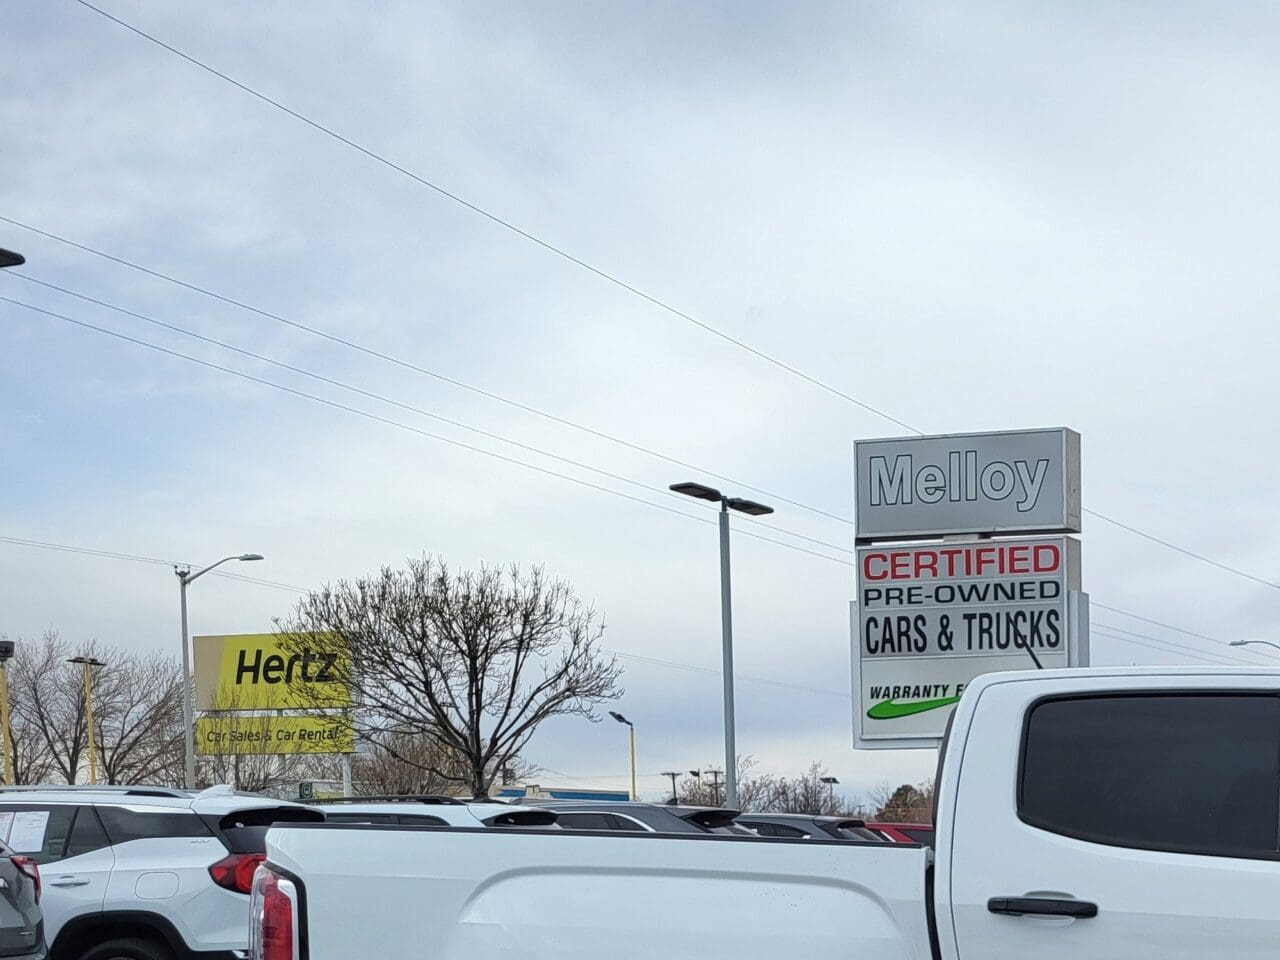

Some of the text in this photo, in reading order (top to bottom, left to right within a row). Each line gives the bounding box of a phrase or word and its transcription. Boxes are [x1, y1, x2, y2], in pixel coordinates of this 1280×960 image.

[869, 450, 1050, 513] Melloy
[863, 544, 1061, 580] CERTIFIED
[864, 580, 1060, 606] PRE-OWNED
[865, 609, 1060, 655] CARS & TRUCKS
[235, 649, 338, 685] Hertz
[870, 684, 949, 699] WARRANTY
[206, 731, 227, 742] Car
[229, 730, 261, 741] Sales
[276, 730, 296, 740] Car
[299, 726, 338, 741] Rental
